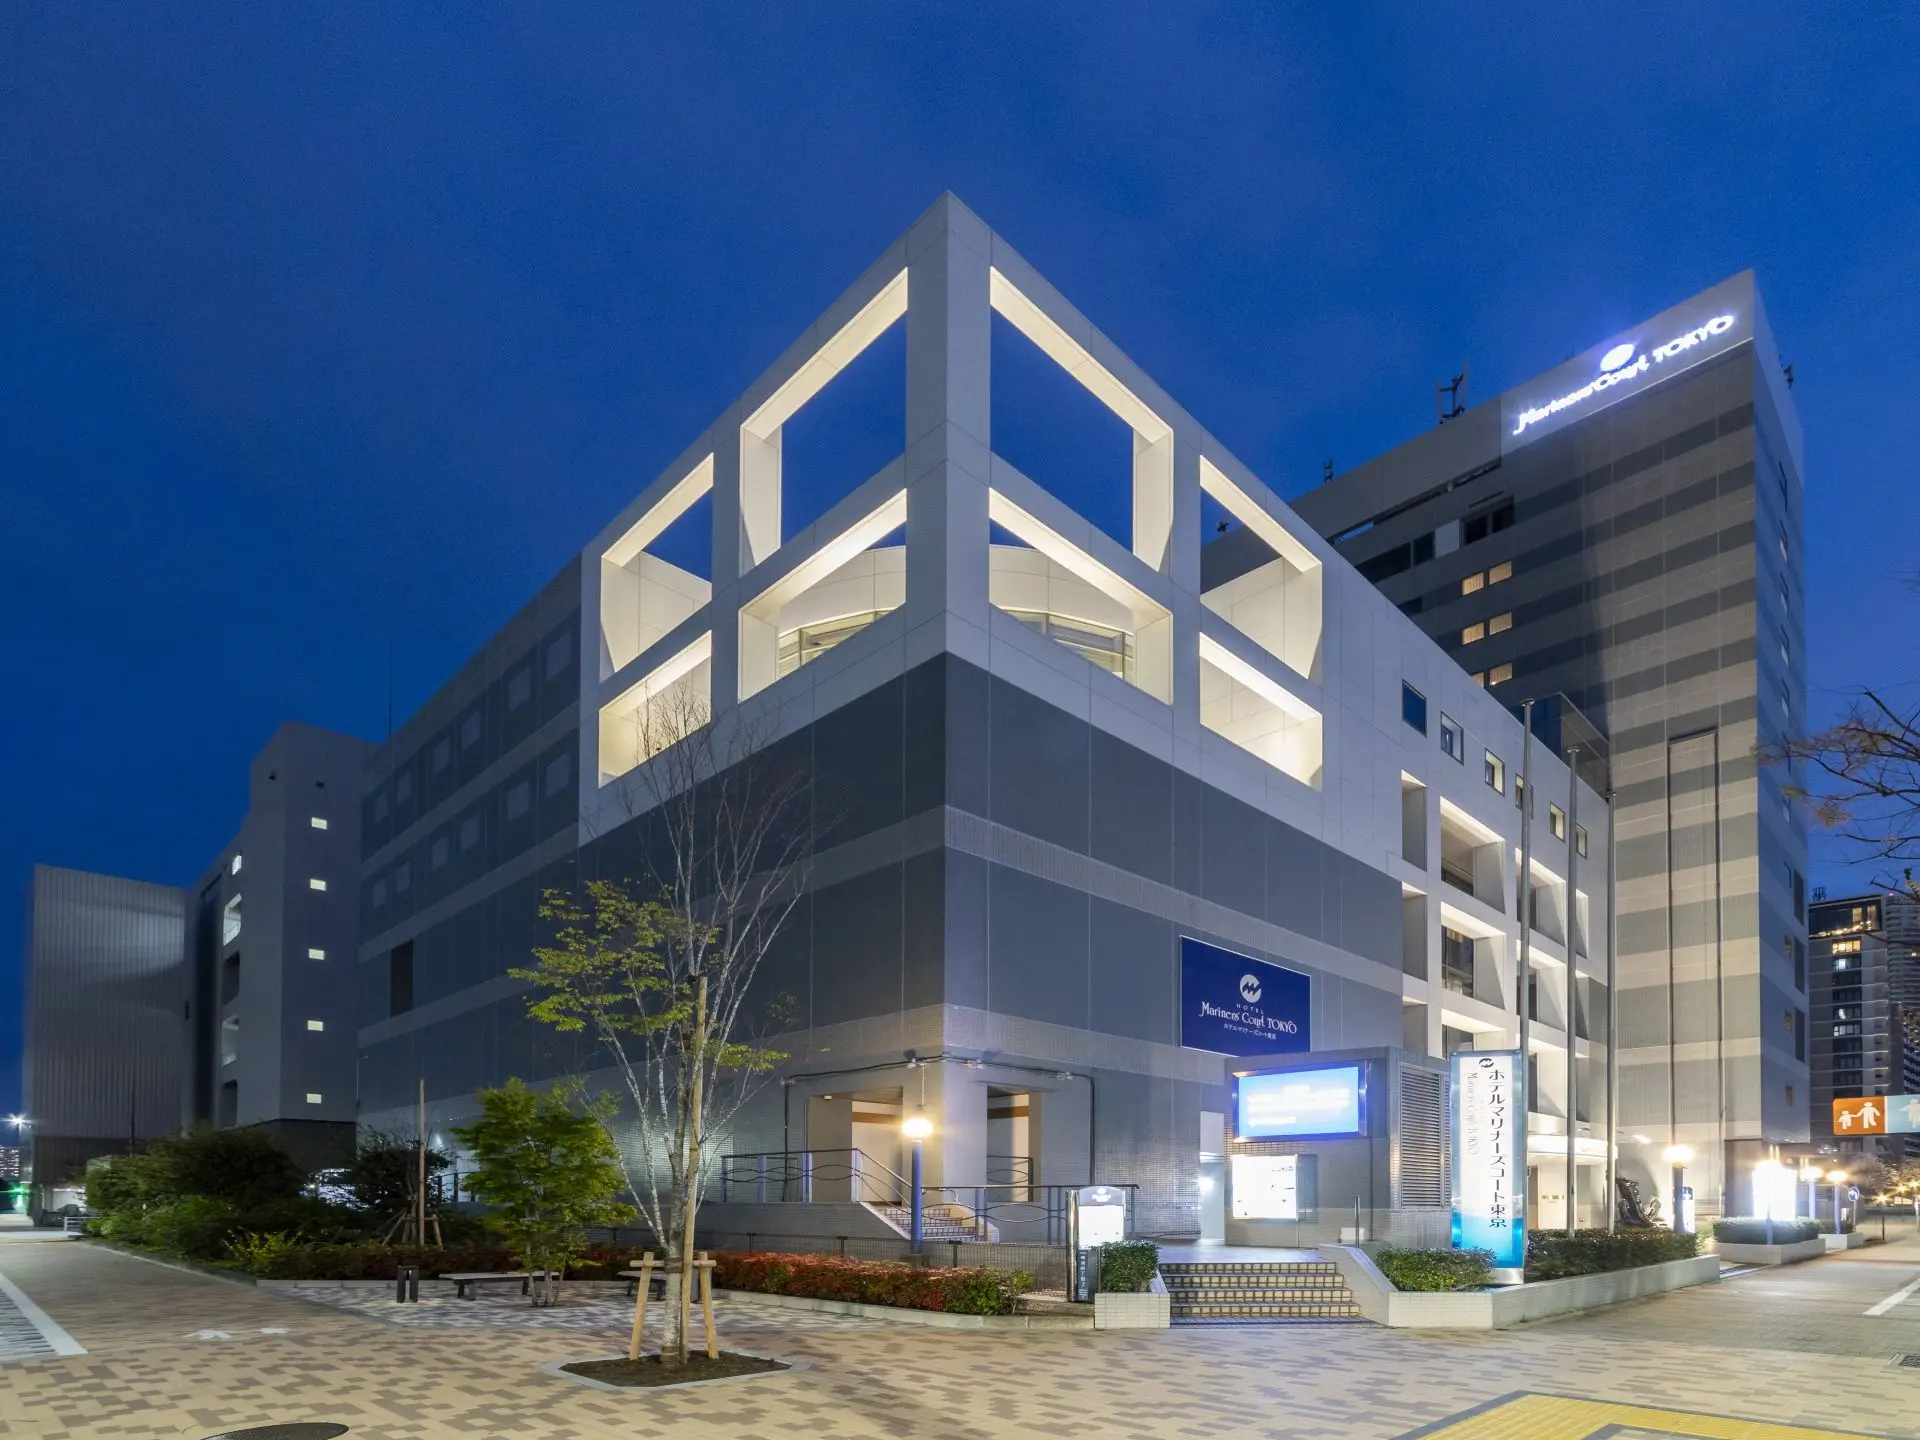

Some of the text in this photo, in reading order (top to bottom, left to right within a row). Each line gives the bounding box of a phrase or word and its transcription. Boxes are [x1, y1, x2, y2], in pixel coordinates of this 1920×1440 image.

[1652, 314, 1735, 363] TOKYO
[1236, 1003, 1264, 1015] HOTEL
[1241, 1012, 1265, 1029] Court
[1266, 1017, 1297, 1034] TOKYO
[1488, 1069, 1507, 1228] ホテルマリナーズコート東京
